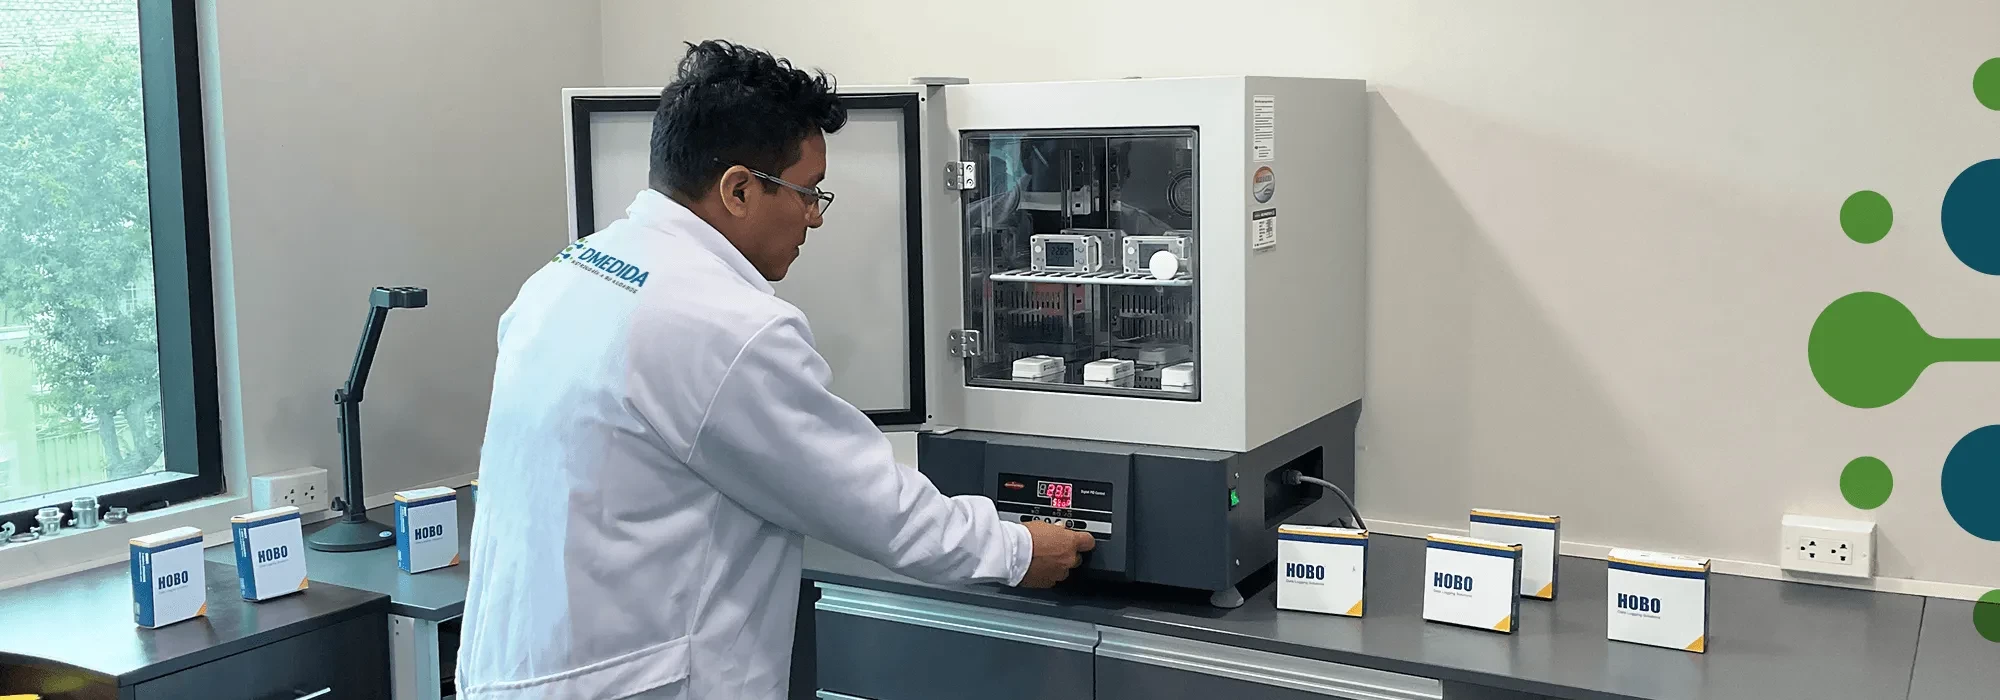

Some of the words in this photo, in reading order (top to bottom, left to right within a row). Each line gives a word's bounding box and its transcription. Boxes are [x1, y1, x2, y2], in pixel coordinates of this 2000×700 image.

[578, 248, 649, 287] DMEDIDA
[415, 524, 443, 540] HOBO
[258, 545, 288, 563] HOBO
[158, 570, 188, 590] HOBO
[1286, 562, 1325, 580] HOBO
[1434, 571, 1473, 592] HOBO
[1618, 593, 1661, 613] HOBO
